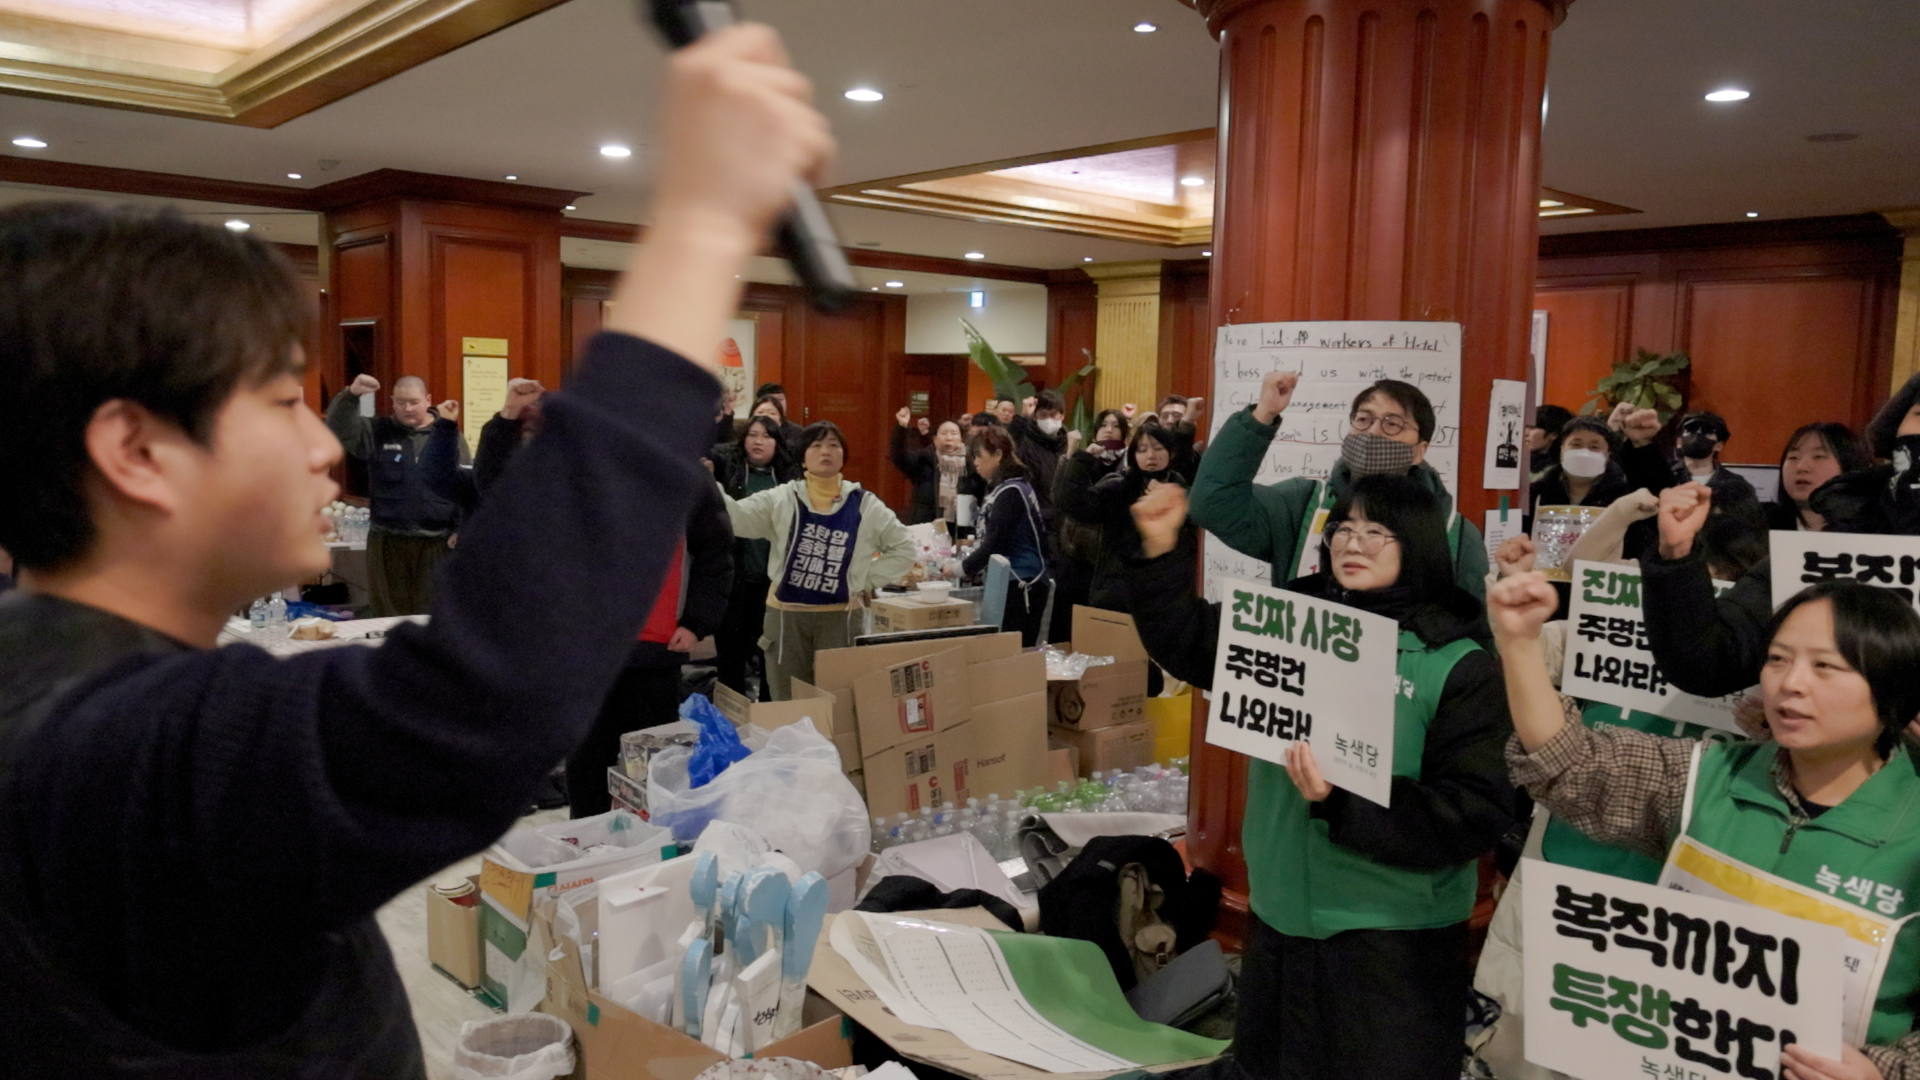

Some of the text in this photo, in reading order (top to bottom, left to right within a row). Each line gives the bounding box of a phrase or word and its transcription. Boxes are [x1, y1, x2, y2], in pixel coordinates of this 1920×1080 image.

[1319, 333, 1372, 350] workers
[1232, 589, 1363, 663] 진짜 사장
[1225, 644, 1306, 697] 주명건
[976, 754, 1006, 768] Hansot
[1334, 733, 1380, 768] 녹색당
[1815, 864, 1904, 916] 녹색당
[1552, 884, 1800, 1006] 복직까지
[1549, 962, 1797, 1080] 투쟁한다
